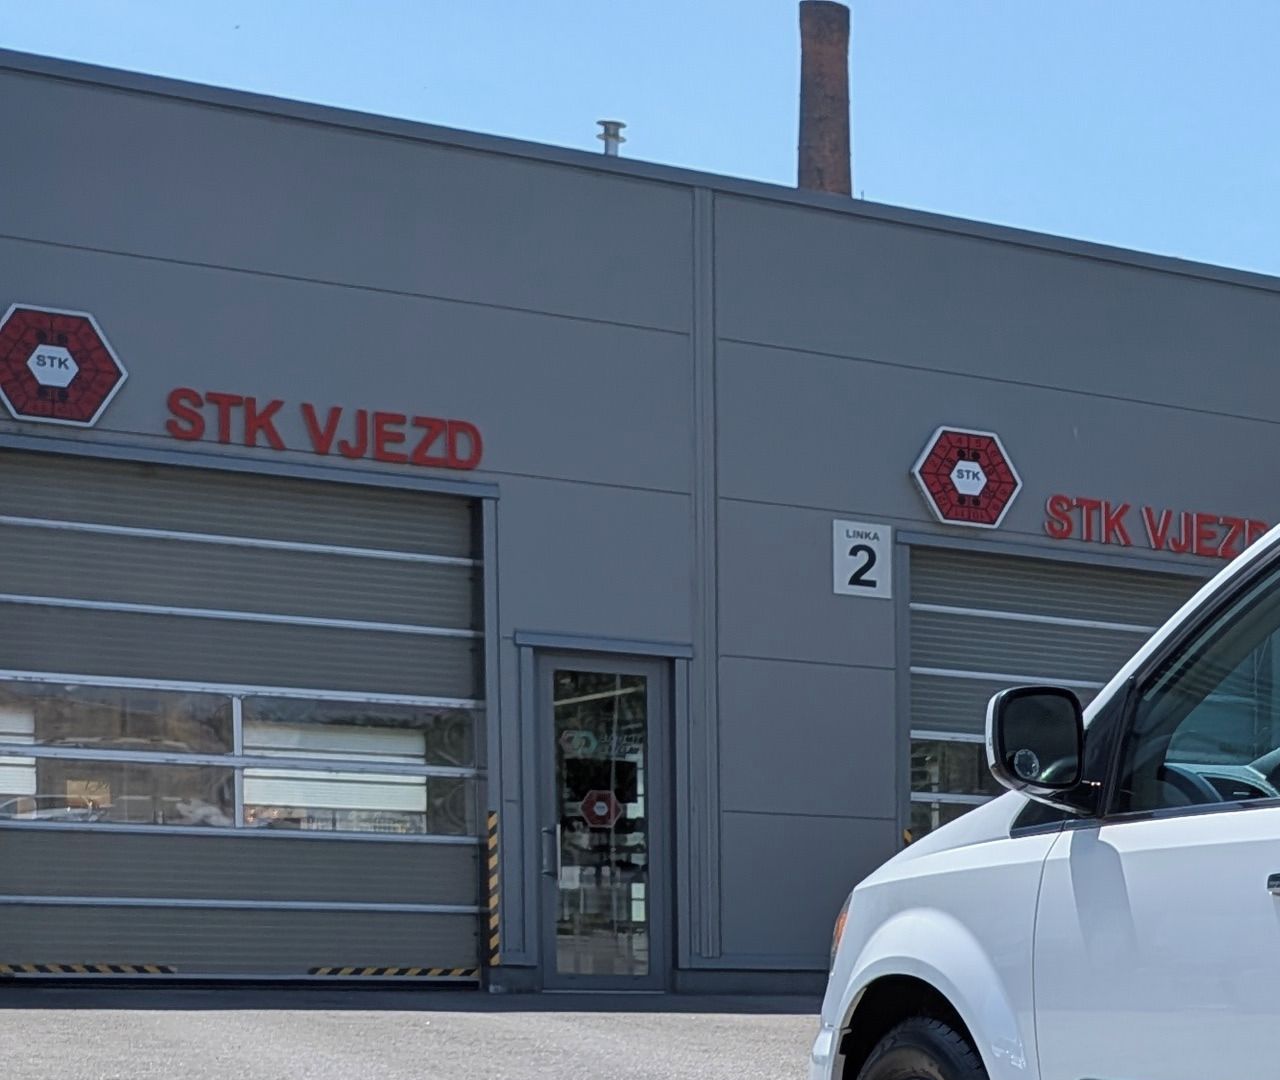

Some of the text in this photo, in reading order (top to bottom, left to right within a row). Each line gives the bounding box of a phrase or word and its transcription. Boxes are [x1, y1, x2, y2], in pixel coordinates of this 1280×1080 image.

[35, 354, 70, 371] STK
[165, 387, 483, 470] STK VJEZD
[955, 468, 981, 482] STK
[845, 529, 880, 542] LINKA
[1043, 495, 1132, 547] STK
[847, 544, 878, 589] 2
